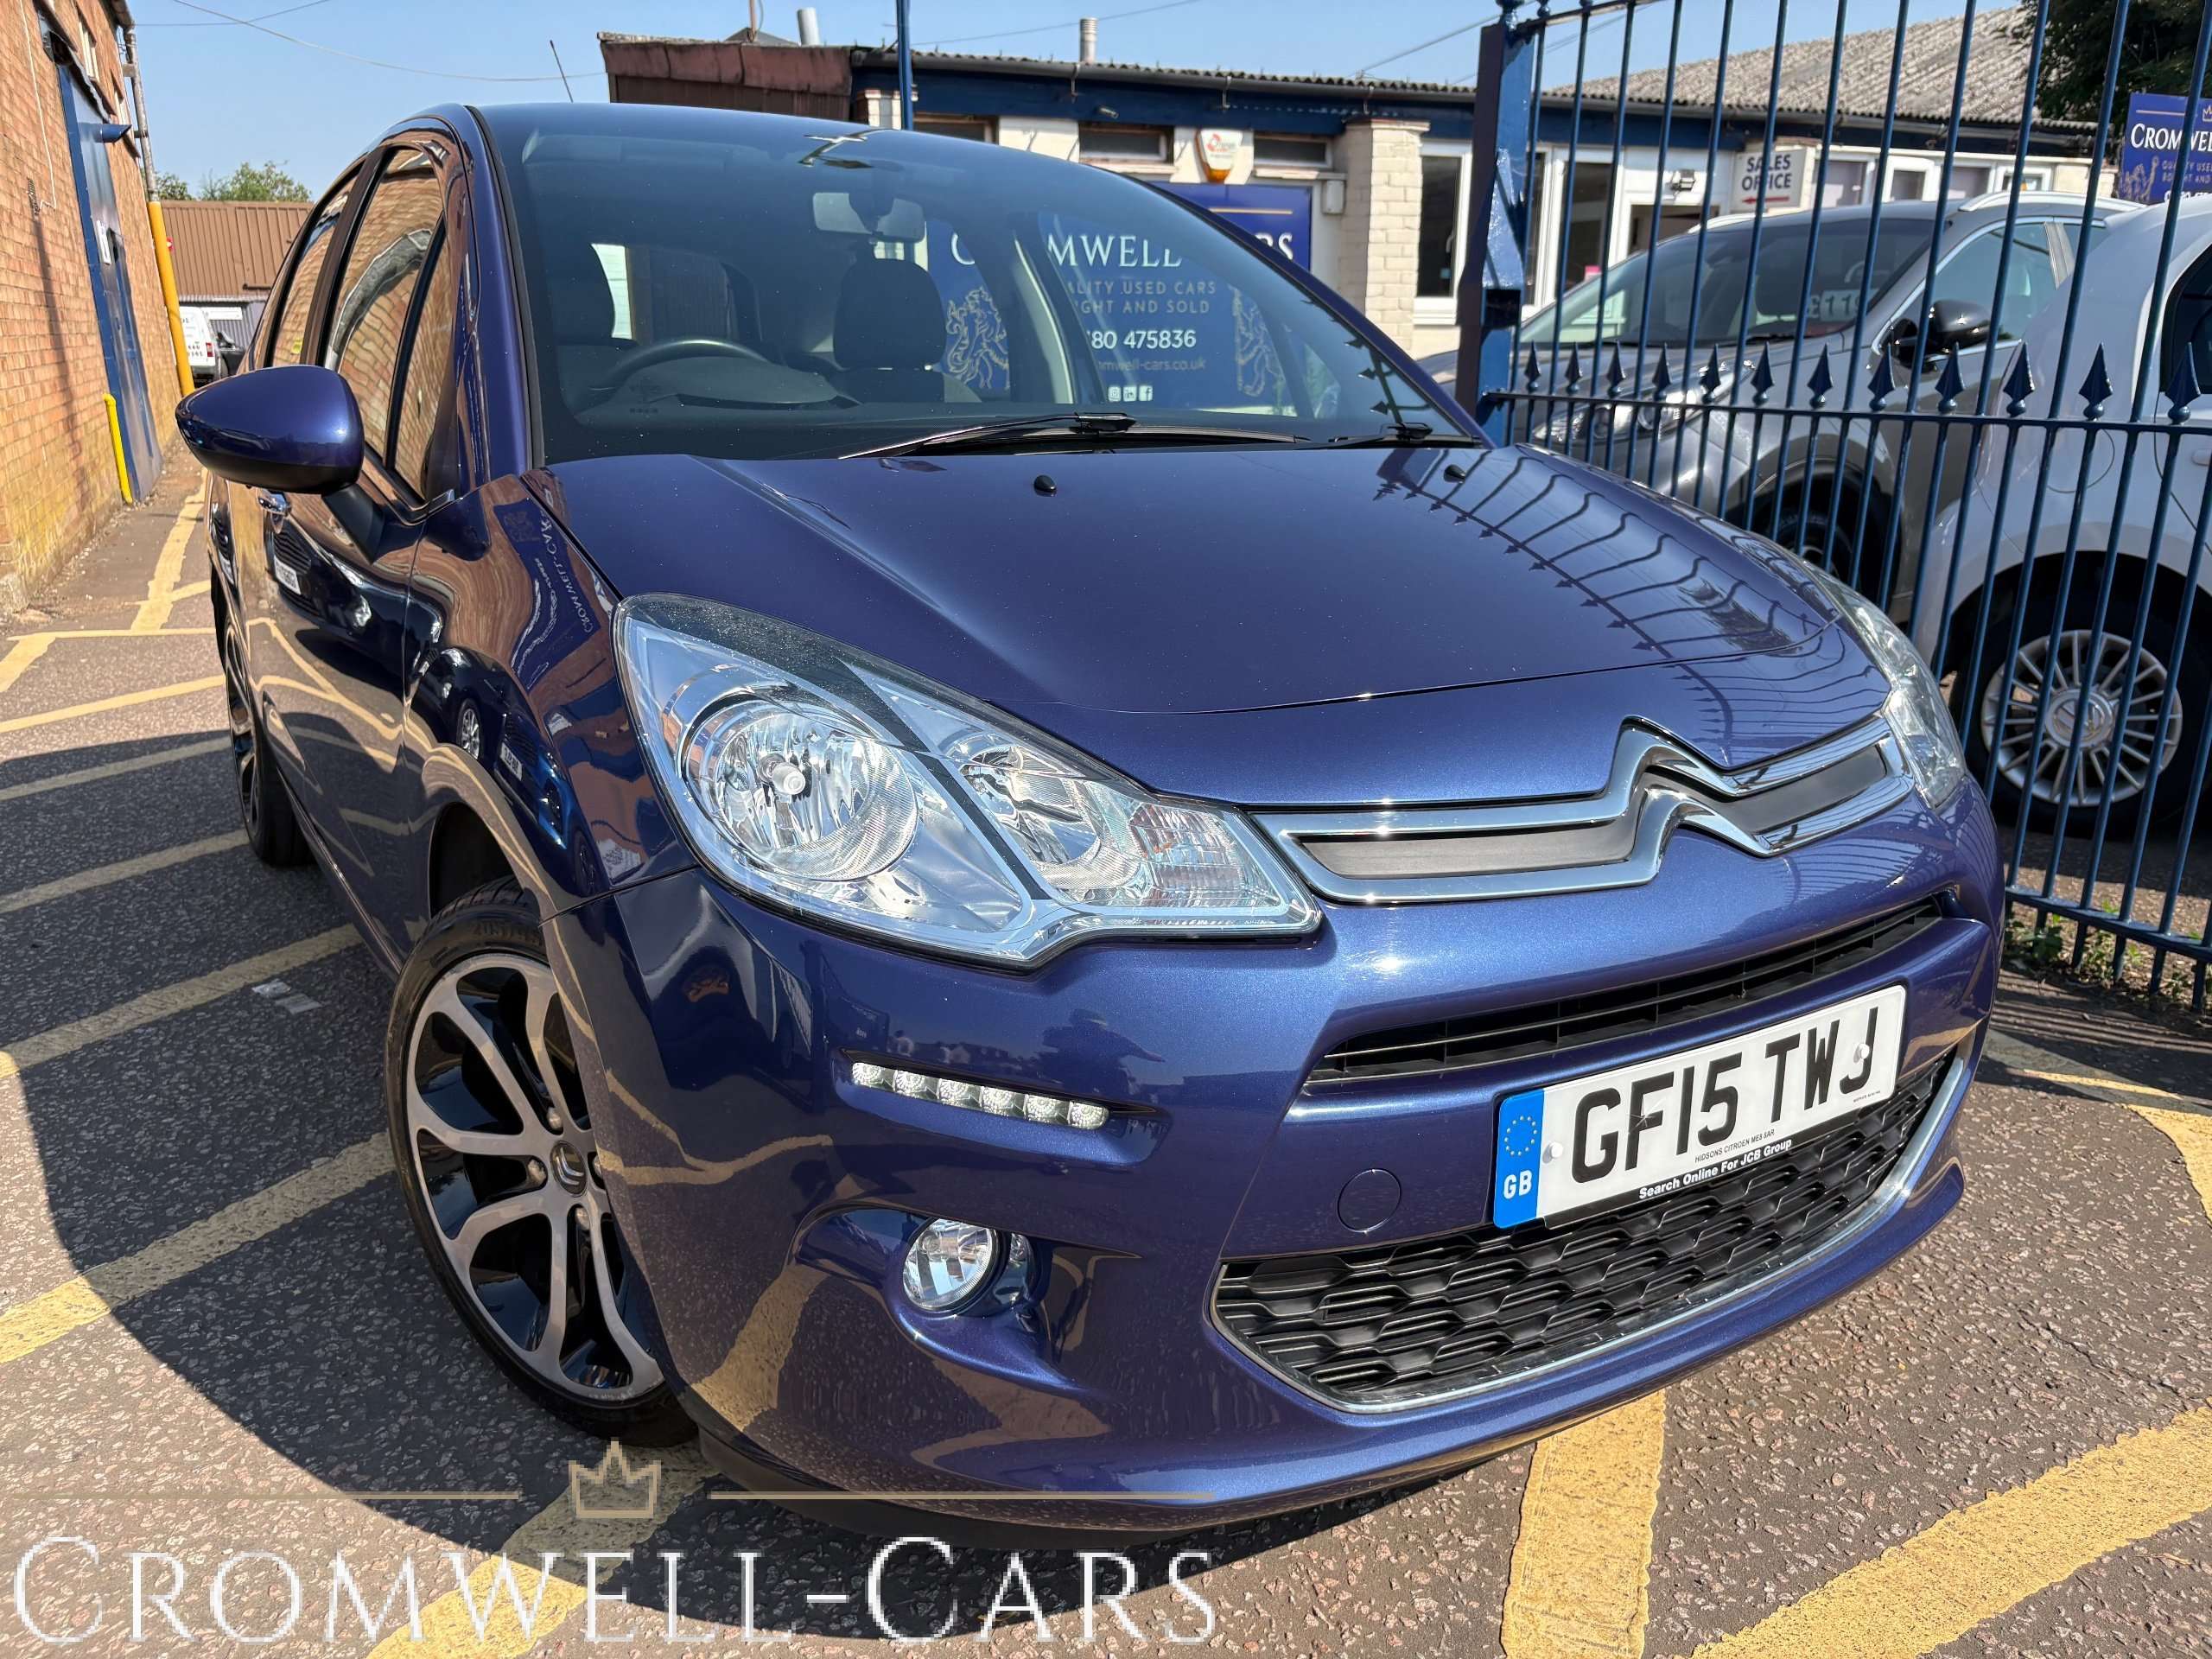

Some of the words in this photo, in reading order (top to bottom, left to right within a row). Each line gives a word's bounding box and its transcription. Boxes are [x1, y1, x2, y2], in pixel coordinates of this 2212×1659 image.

[1741, 173, 1792, 191] OFICE
[1123, 281, 1166, 295] USED
[1174, 281, 1216, 295] CARS
[1123, 300, 1158, 314] AND
[1166, 300, 1210, 314] SOLD
[1123, 329, 1197, 349] 475836
[1572, 1052, 1743, 1184] GF15
[1765, 1007, 1878, 1123] TWJ
[1639, 1178, 1680, 1199] Search
[1683, 1166, 1718, 1184] Online
[1721, 1160, 1738, 1173] For
[1740, 1152, 1761, 1166] JCB
[1764, 1139, 1792, 1156] Group
[1503, 1169, 1532, 1199] GB
